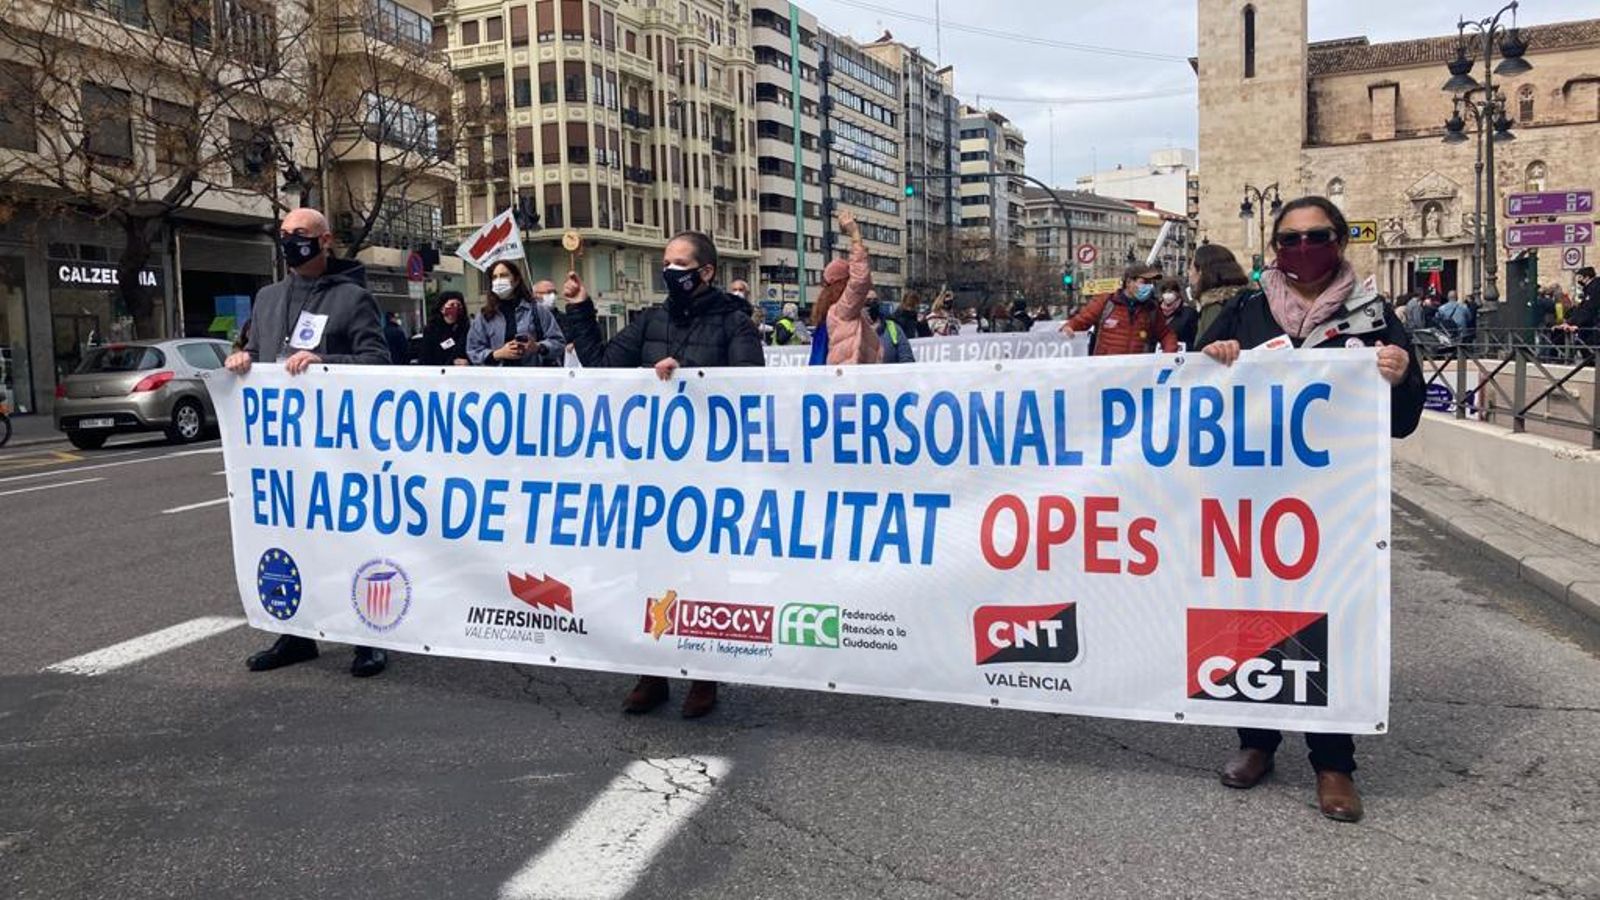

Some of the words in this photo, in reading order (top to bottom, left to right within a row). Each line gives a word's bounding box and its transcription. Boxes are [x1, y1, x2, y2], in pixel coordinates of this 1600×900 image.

[59, 265, 157, 286] CALZEDIA
[959, 339, 1073, 361] 19/03/2020
[242, 387, 305, 447] PER
[314, 389, 358, 449] LA
[369, 381, 696, 462] CONSOLIDACIÓ
[706, 394, 790, 463] DEL
[803, 390, 1084, 467] PERSONAL
[1099, 369, 1332, 468] PÚBLIC
[250, 467, 295, 528] EN
[306, 460, 429, 536] ABÚS
[441, 477, 510, 542] DE
[520, 480, 951, 565] TEMPORALITAT
[980, 493, 1159, 577] OPEs
[1201, 497, 1320, 580] NO
[466, 606, 588, 635] INTERSINDICAL
[682, 604, 771, 633] USOCV
[842, 608, 896, 622] Federación
[464, 626, 533, 642] VALENCIANA
[842, 622, 885, 636] Atención
[887, 629, 895, 637] a
[896, 627, 907, 637] la
[988, 620, 1063, 649] CNT
[842, 637, 898, 651] Ciudadanía
[984, 671, 1072, 692] VALÈNCIA
[1197, 655, 1320, 703] CGT
